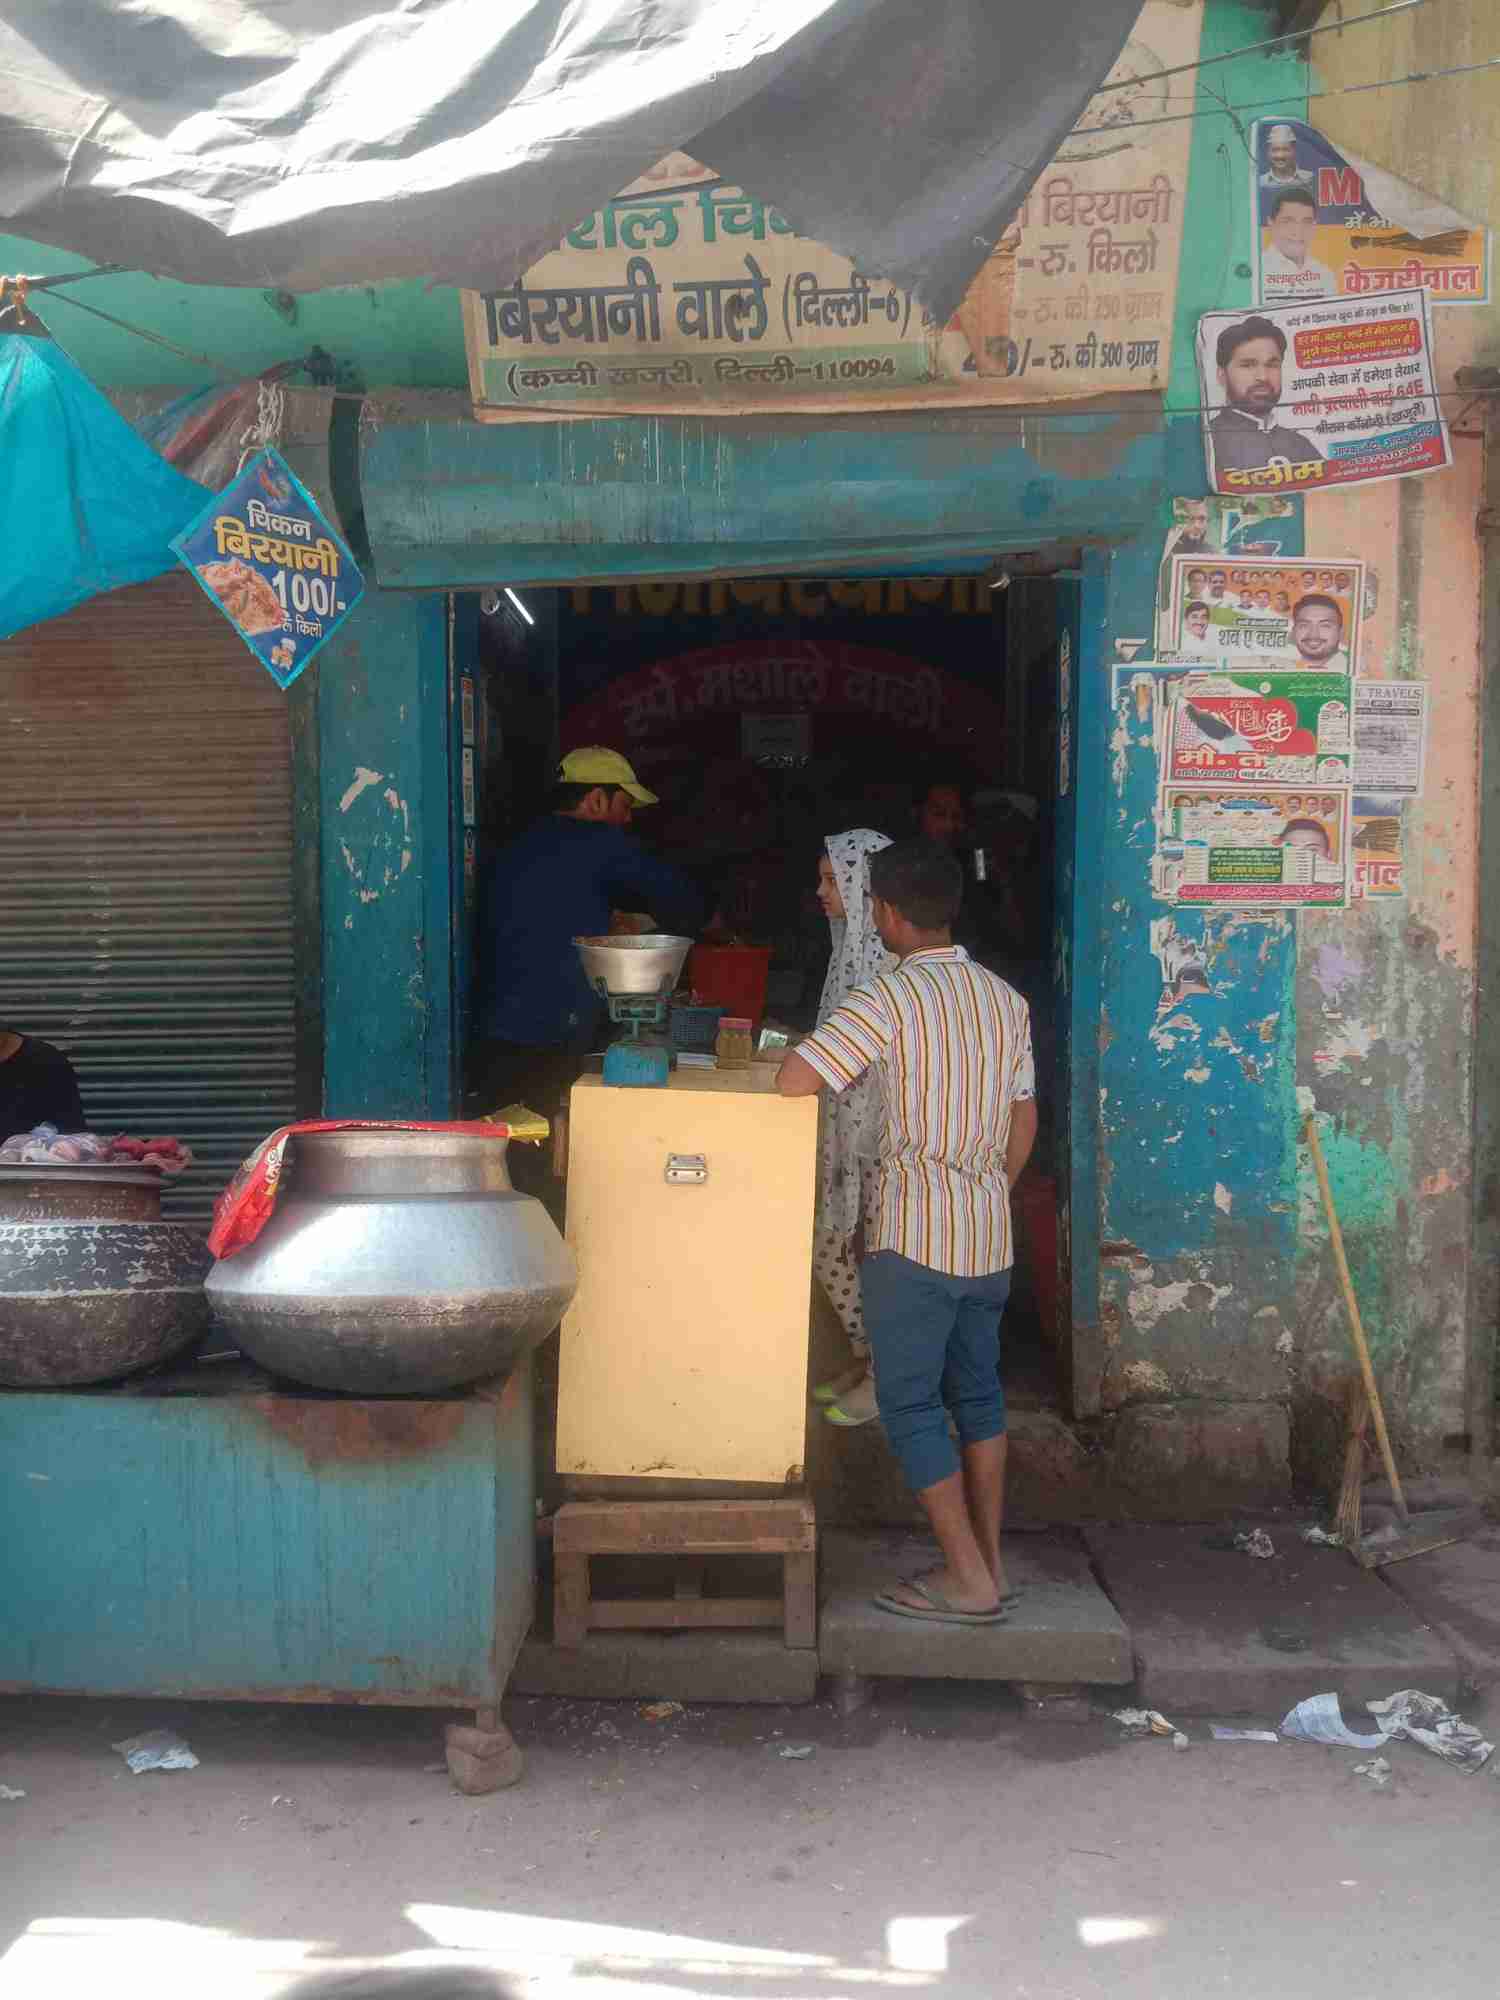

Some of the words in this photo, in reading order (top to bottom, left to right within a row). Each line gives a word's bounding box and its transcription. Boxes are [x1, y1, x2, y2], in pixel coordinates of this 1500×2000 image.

[1042, 175, 1176, 227] बिरयानी
[1086, 228, 1160, 275] किलो
[480, 255, 661, 346] बिरयानी
[673, 253, 771, 343] वाले
[1075, 331, 1097, 369] की
[1101, 342, 1123, 368] 500
[1127, 340, 1160, 370] ग्राम
[1291, 373, 1326, 391] आपकी
[1327, 370, 1349, 387] सेवा
[246, 499, 313, 541] चिकन
[213, 515, 340, 577] बिरयानी
[272, 570, 346, 618] 100/-
[295, 613, 323, 639] किलो
[1368, 687, 1422, 700] TRAVELS
